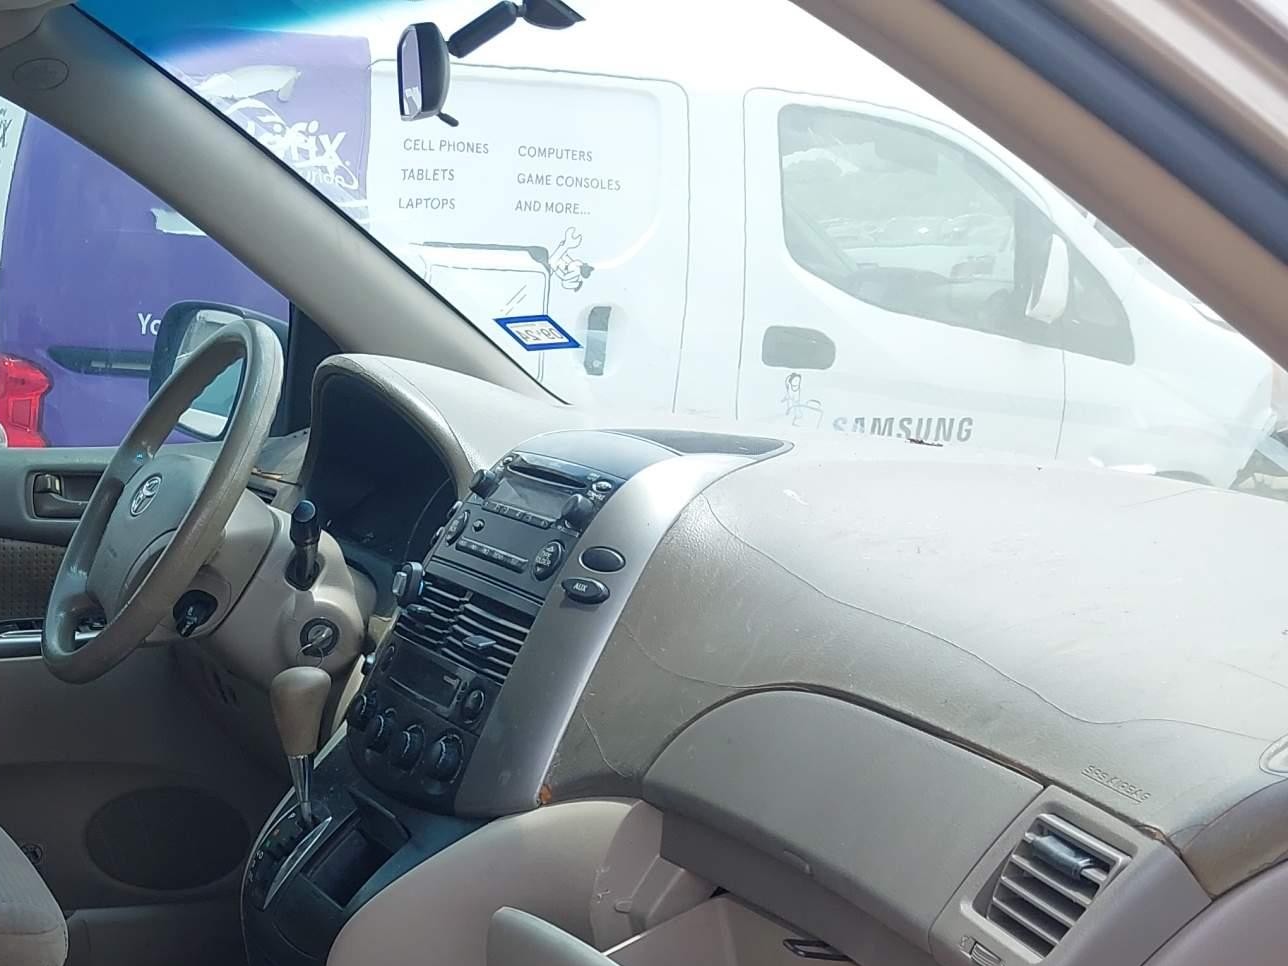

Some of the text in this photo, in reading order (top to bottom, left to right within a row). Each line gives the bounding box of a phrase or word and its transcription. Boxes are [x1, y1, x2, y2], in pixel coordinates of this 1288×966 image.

[404, 138, 489, 154] CELL PHONES
[518, 145, 593, 162] COMPUTERS
[401, 168, 455, 181] TABLETS
[517, 172, 621, 191] GAME CONSOLES
[398, 197, 456, 210] LAPTOPS
[515, 199, 542, 212] AND
[832, 416, 974, 443] SAMSUNG
[572, 582, 589, 593] AUX
